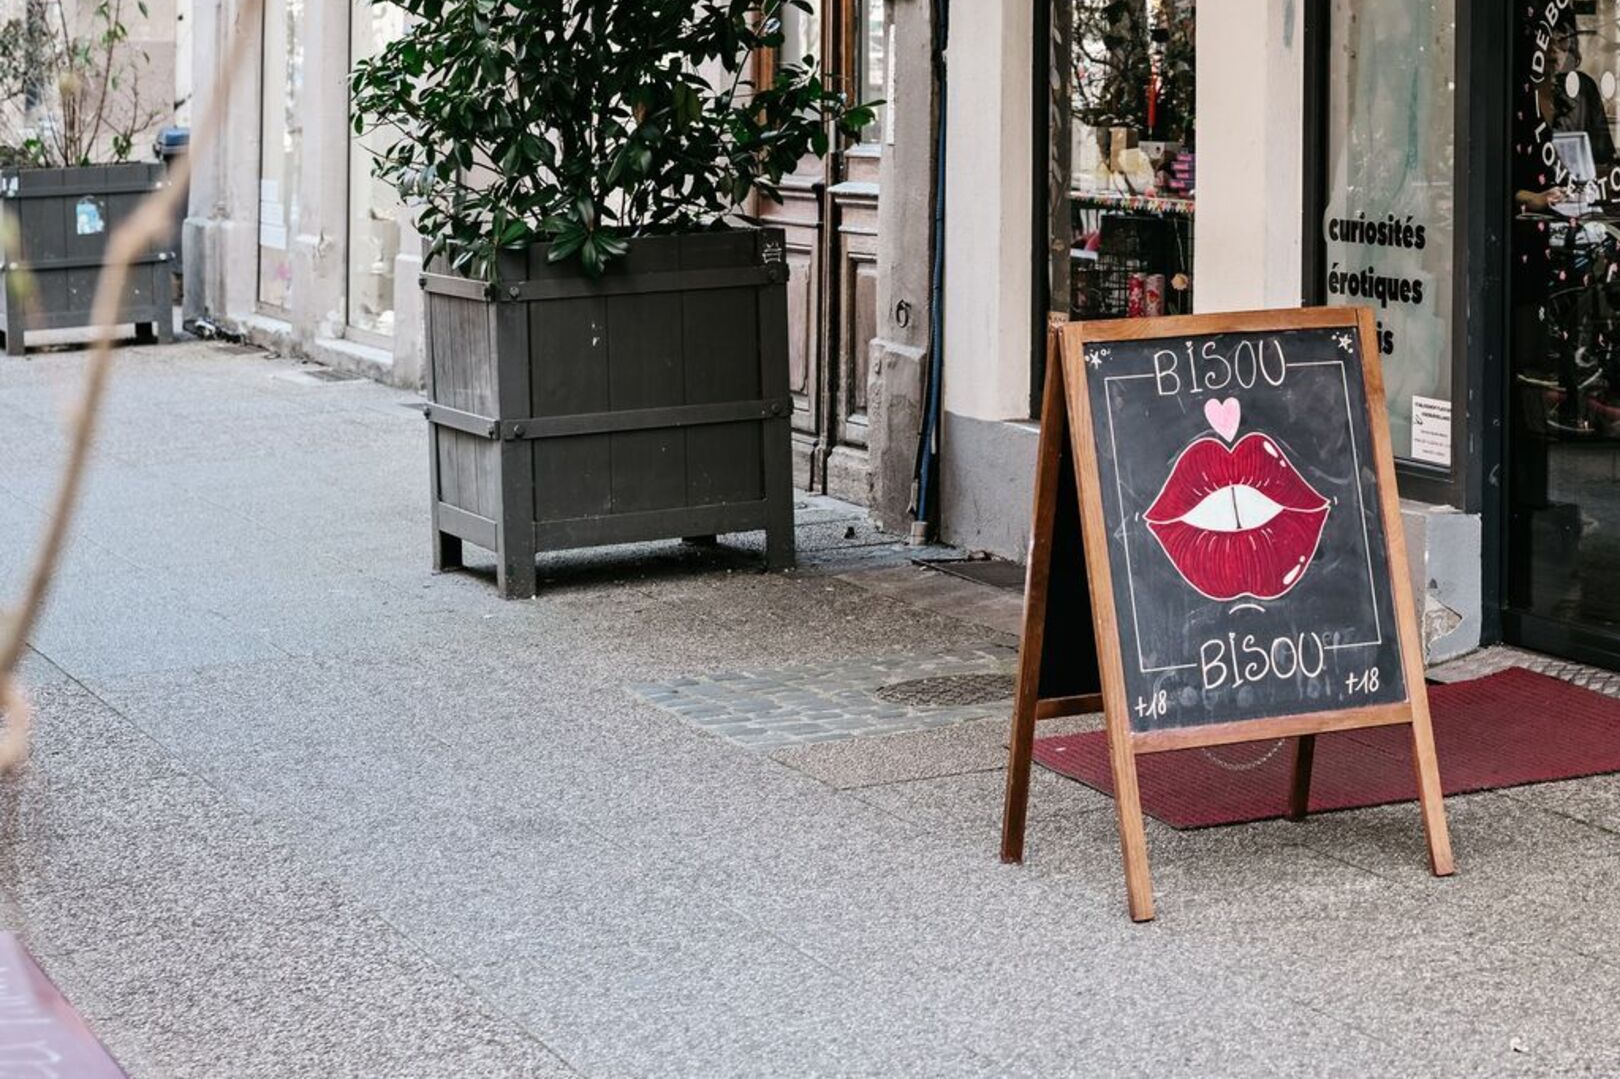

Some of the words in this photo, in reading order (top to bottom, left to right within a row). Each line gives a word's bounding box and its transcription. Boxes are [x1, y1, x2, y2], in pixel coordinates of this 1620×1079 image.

[1535, 121, 1577, 198] LOVE
[1328, 211, 1426, 250] curiosités
[1328, 262, 1423, 309] érotiques
[1153, 339, 1287, 396] BISOU
[1200, 631, 1325, 690] BISOU
[1345, 667, 1380, 696] +18
[1135, 690, 1168, 719] +18
